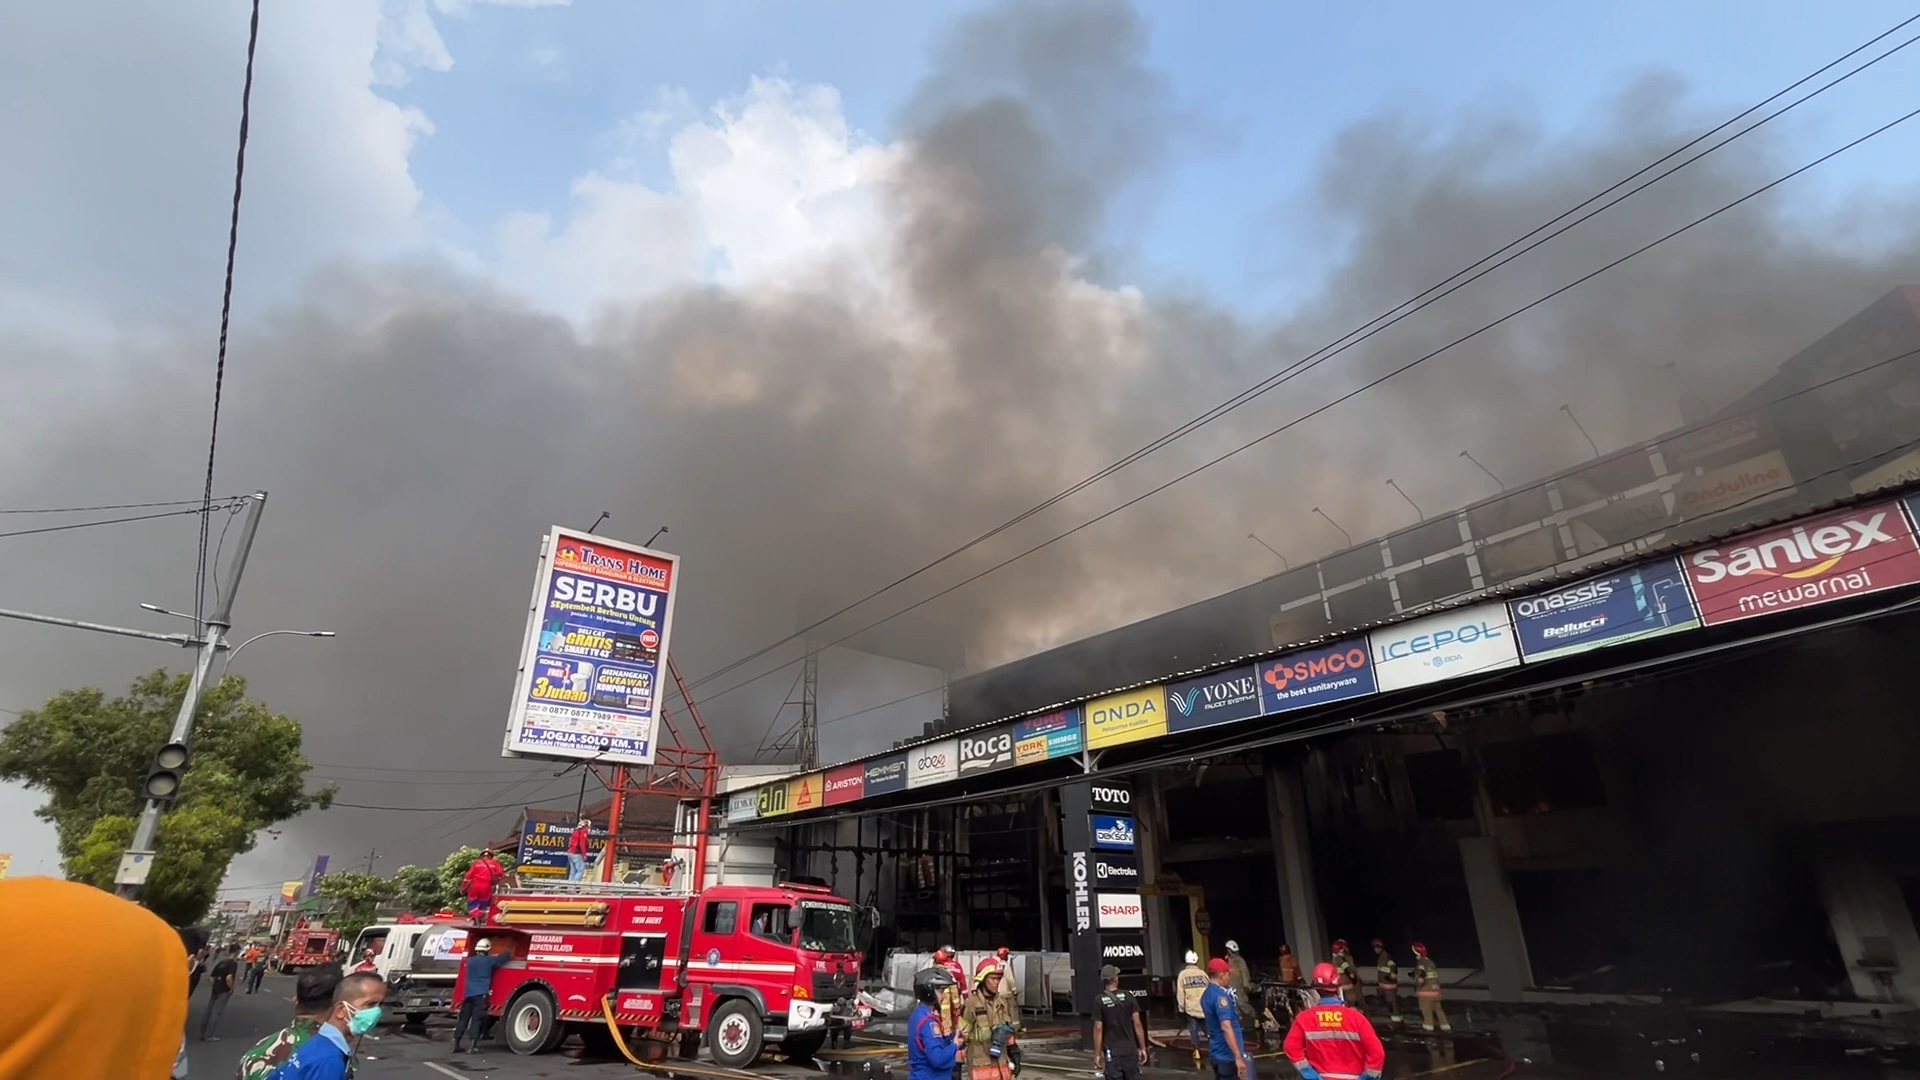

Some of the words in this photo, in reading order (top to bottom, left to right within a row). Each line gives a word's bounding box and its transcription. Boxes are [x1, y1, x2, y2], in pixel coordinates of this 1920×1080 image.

[1692, 512, 1894, 584] Sanlex
[628, 558, 667, 580] HOME
[554, 576, 658, 617] SERBU
[1517, 580, 1613, 617] onassis
[1739, 567, 1872, 612] mewarnai
[597, 606, 628, 619] Berburu
[629, 613, 656, 629] Untung
[1543, 615, 1606, 640] Bellucci
[566, 632, 614, 651] GRATIS
[578, 628, 592, 636] BELI
[1381, 622, 1502, 662] ICEPOL
[564, 646, 589, 656] SMART
[589, 649, 600, 657] TV
[602, 668, 649, 681] MENANGKAN
[1294, 648, 1366, 682] SMCO
[1203, 677, 1255, 702] VONE
[1277, 691, 1289, 701] the
[1290, 688, 1307, 698] best
[1308, 677, 1358, 694] sanitaryware
[549, 706, 569, 716] 0877
[571, 709, 591, 718] 0877
[592, 711, 612, 721] 7989
[1092, 698, 1157, 725] ONDA
[522, 729, 538, 739] JL.
[540, 730, 609, 747] JOGJA-SOLO
[611, 739, 632, 749] KM.
[634, 741, 645, 750] 11
[960, 732, 1012, 761] Roca
[1016, 740, 1044, 753] YORK
[832, 776, 863, 791] ARISTON
[1092, 787, 1130, 805] TOTO
[525, 834, 565, 848] SABAR
[1108, 866, 1138, 876] Electrolux
[1100, 905, 1140, 916] SHARP
[1103, 945, 1144, 958] MODENA
[1316, 1011, 1343, 1022] TRC
